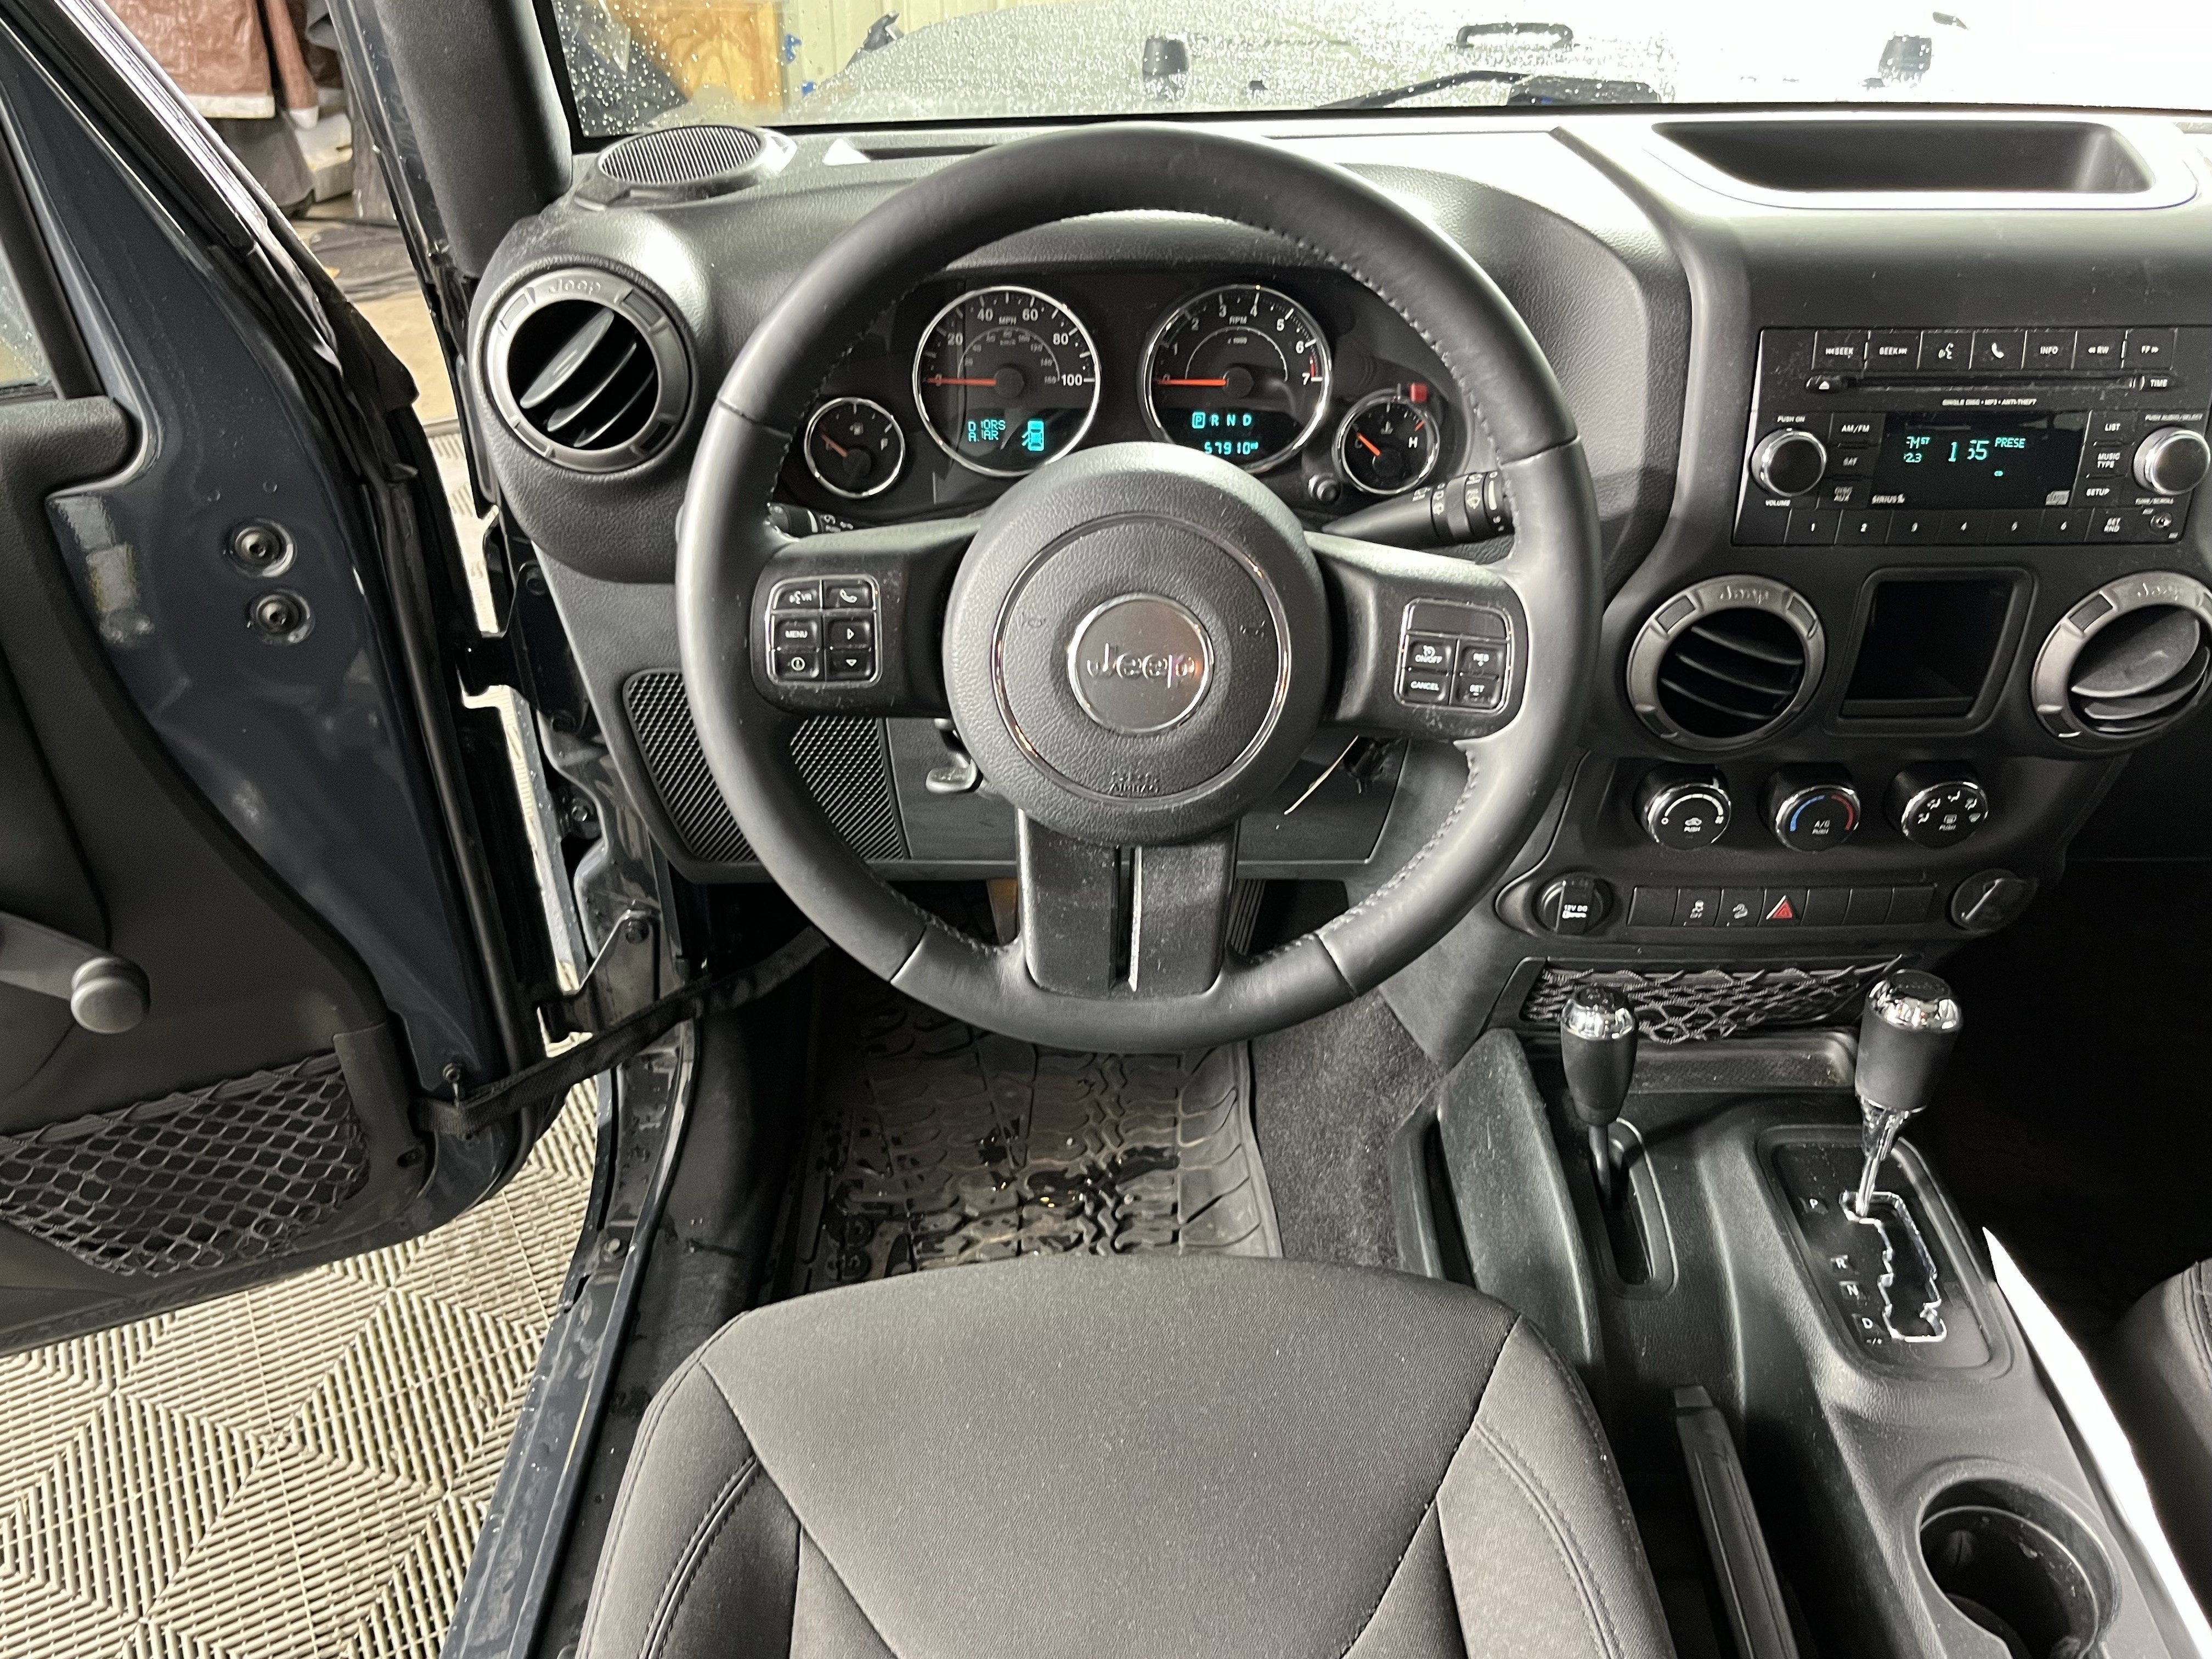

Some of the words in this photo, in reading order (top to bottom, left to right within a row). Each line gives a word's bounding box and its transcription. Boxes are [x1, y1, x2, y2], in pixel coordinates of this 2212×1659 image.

[977, 308, 994, 321] 40
[1022, 308, 1039, 321] 60
[1219, 306, 1227, 318] 3
[1250, 303, 1258, 317] 4
[999, 315, 1017, 325] MPH
[1192, 318, 1199, 330] 2
[1229, 316, 1247, 325] RPM
[1277, 319, 1285, 331] 5
[947, 332, 963, 346] 20
[1053, 332, 1068, 345] 80
[1173, 343, 1178, 354] 1
[1295, 341, 1305, 354] 6
[1835, 347, 1854, 356] SEEK
[1880, 347, 1898, 356] SEEK
[2040, 346, 2058, 354] INFO
[2096, 346, 2109, 354] RW
[1061, 374, 1082, 386] 100
[1302, 373, 1310, 385] 7
[2150, 379, 2168, 387] TIME
[1211, 414, 1218, 426] R
[1227, 414, 1235, 426] N
[1243, 414, 1251, 426] D
[2104, 423, 2120, 431] LIST
[1408, 437, 1418, 448] H
[1995, 437, 2026, 448] PRESE
[2098, 453, 2120, 461] MUSIC
[2086, 488, 2110, 496] SETUP
[1860, 523, 1867, 532] 2
[785, 630, 808, 639] MENU
[1087, 642, 1195, 689] Jeep
[1410, 681, 1439, 691] CANCEL
[1809, 1199, 1818, 1209] P
[1836, 1258, 1847, 1269] R
[1847, 1285, 1858, 1296] N
[1862, 1317, 1873, 1329] D
